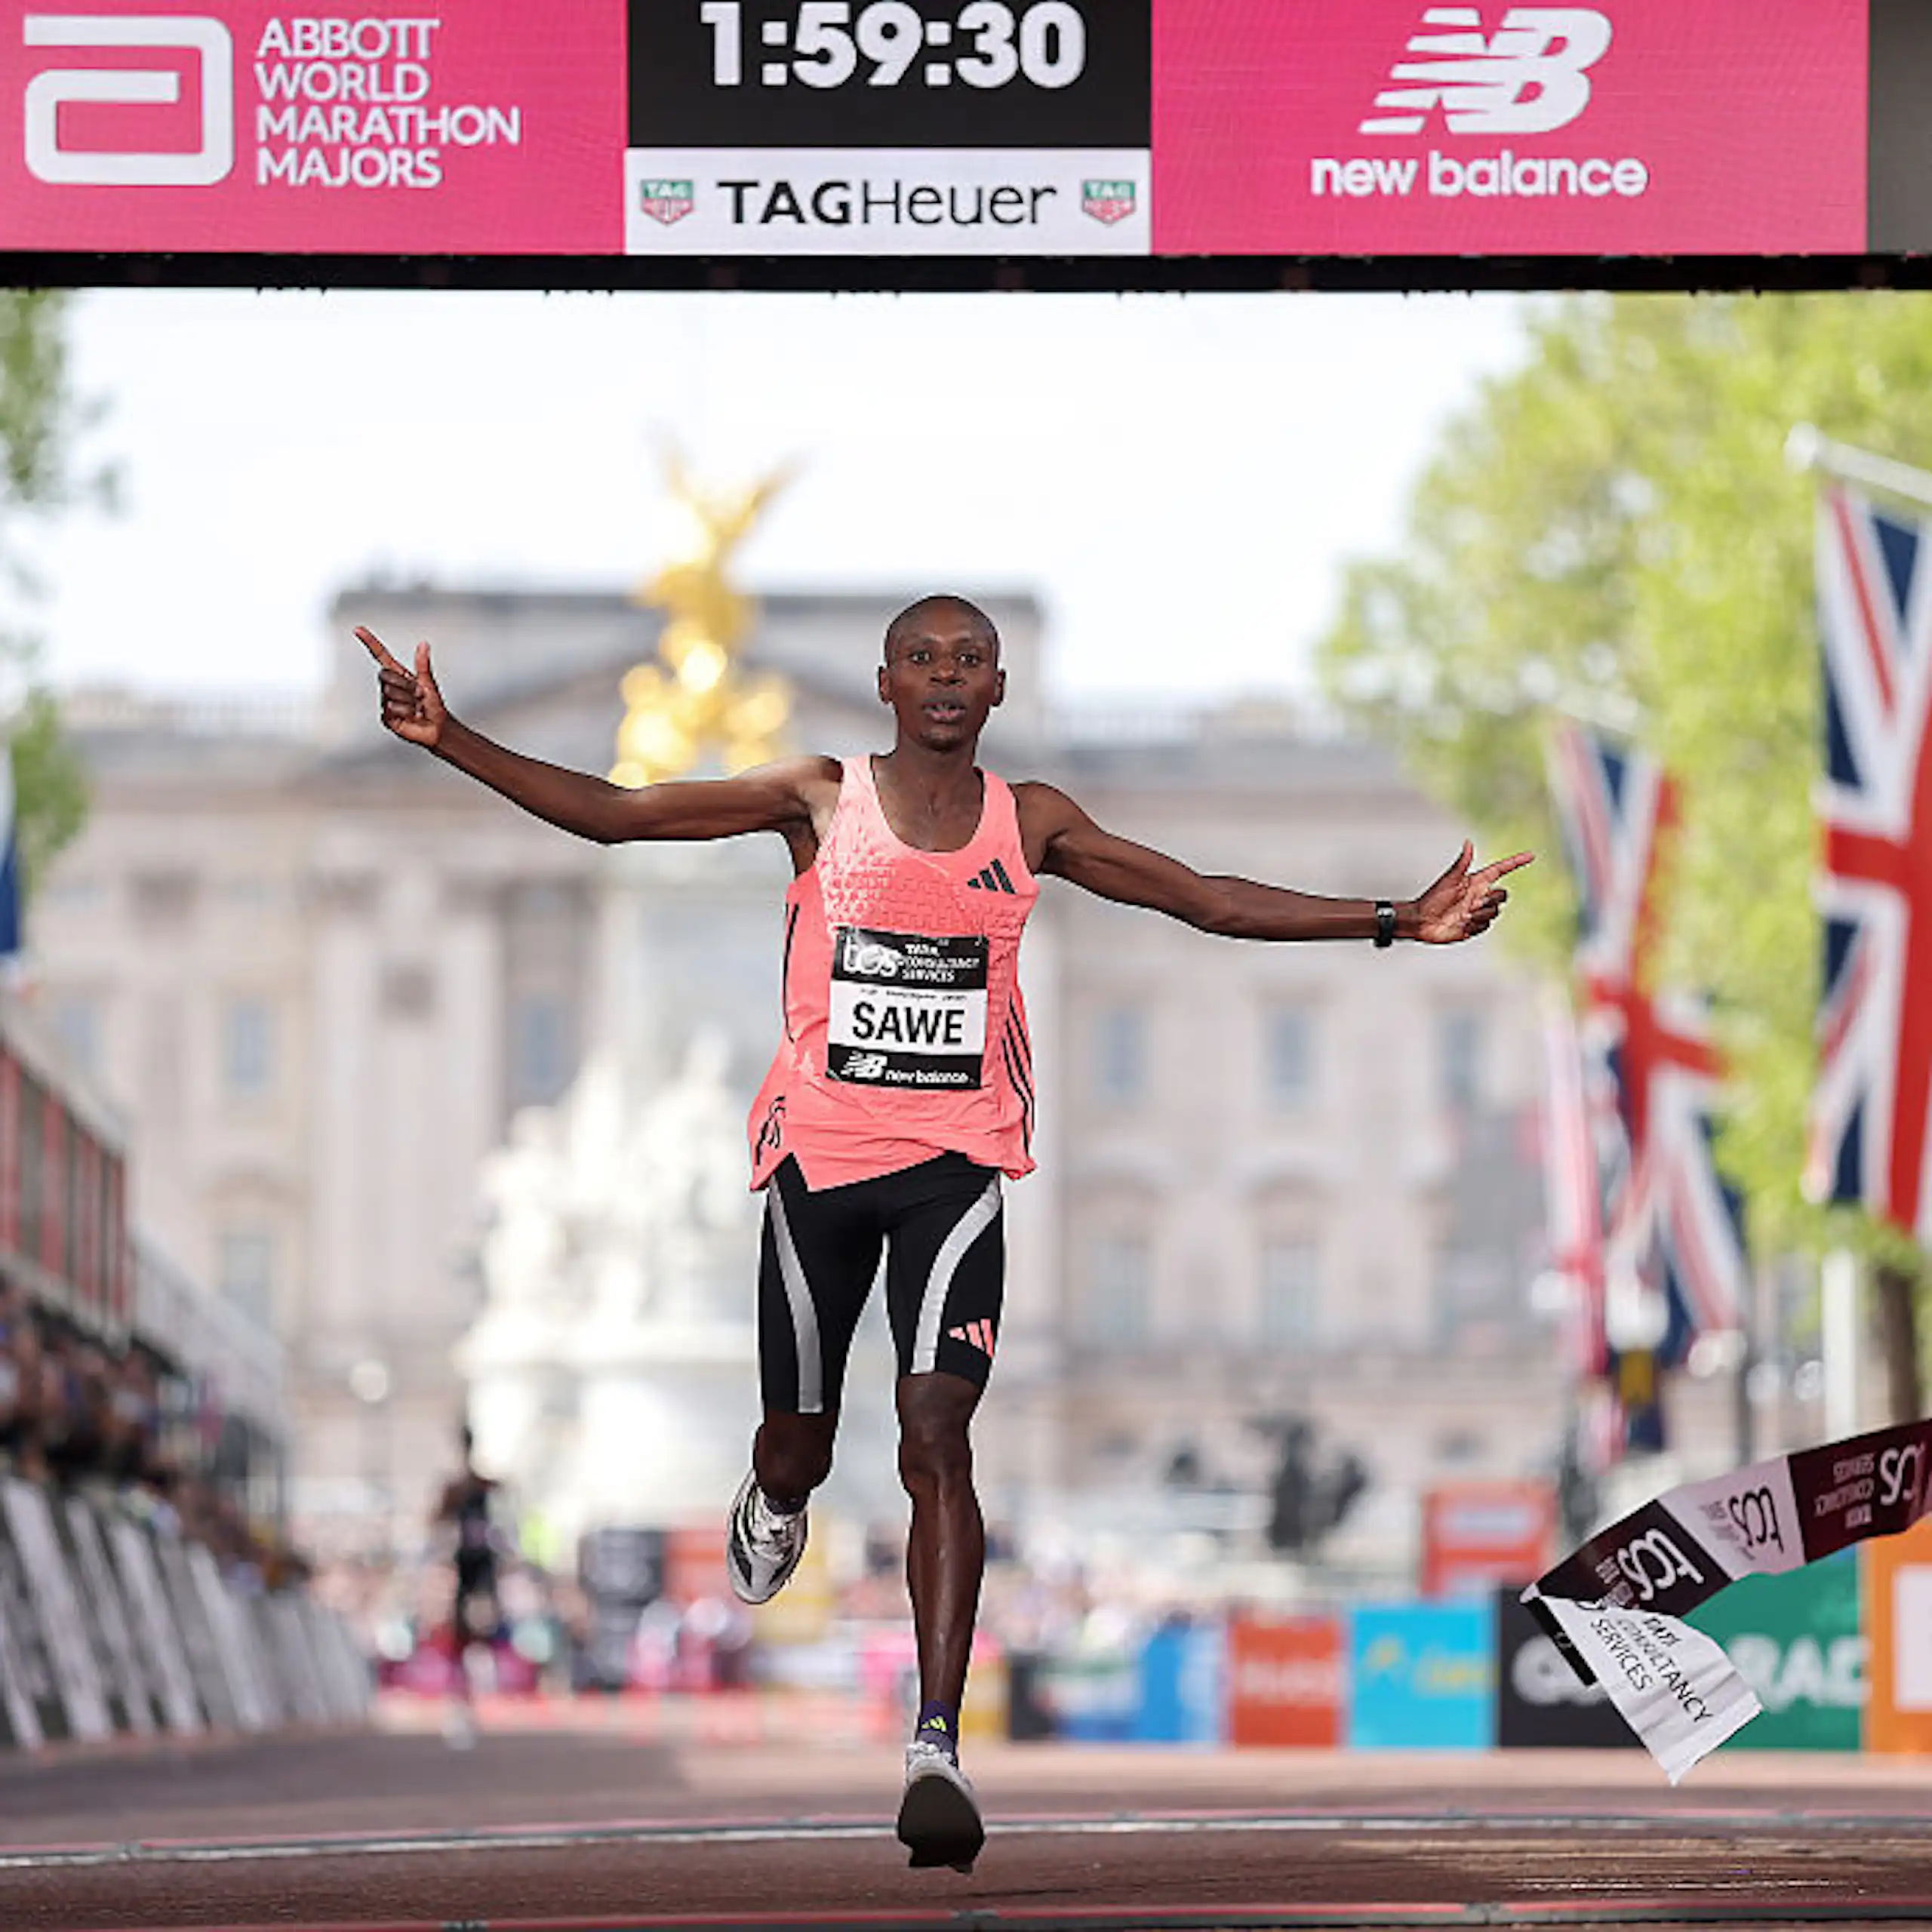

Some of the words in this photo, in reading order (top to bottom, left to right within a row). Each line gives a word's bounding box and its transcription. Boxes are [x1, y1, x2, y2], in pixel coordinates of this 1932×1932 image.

[257, 17, 441, 59] ABBOTT
[701, 2, 1085, 88] 1:59:30
[254, 61, 431, 102] WORLD
[257, 105, 520, 146] MARATHON
[257, 148, 442, 189] MAJORS
[1311, 158, 1417, 197] new
[1429, 149, 1648, 198] balance
[853, 1001, 965, 1044] SAWE
[915, 1069, 969, 1084] balance
[1617, 1528, 1705, 1601] tcs
[1590, 1618, 1655, 1692] SERVICES
